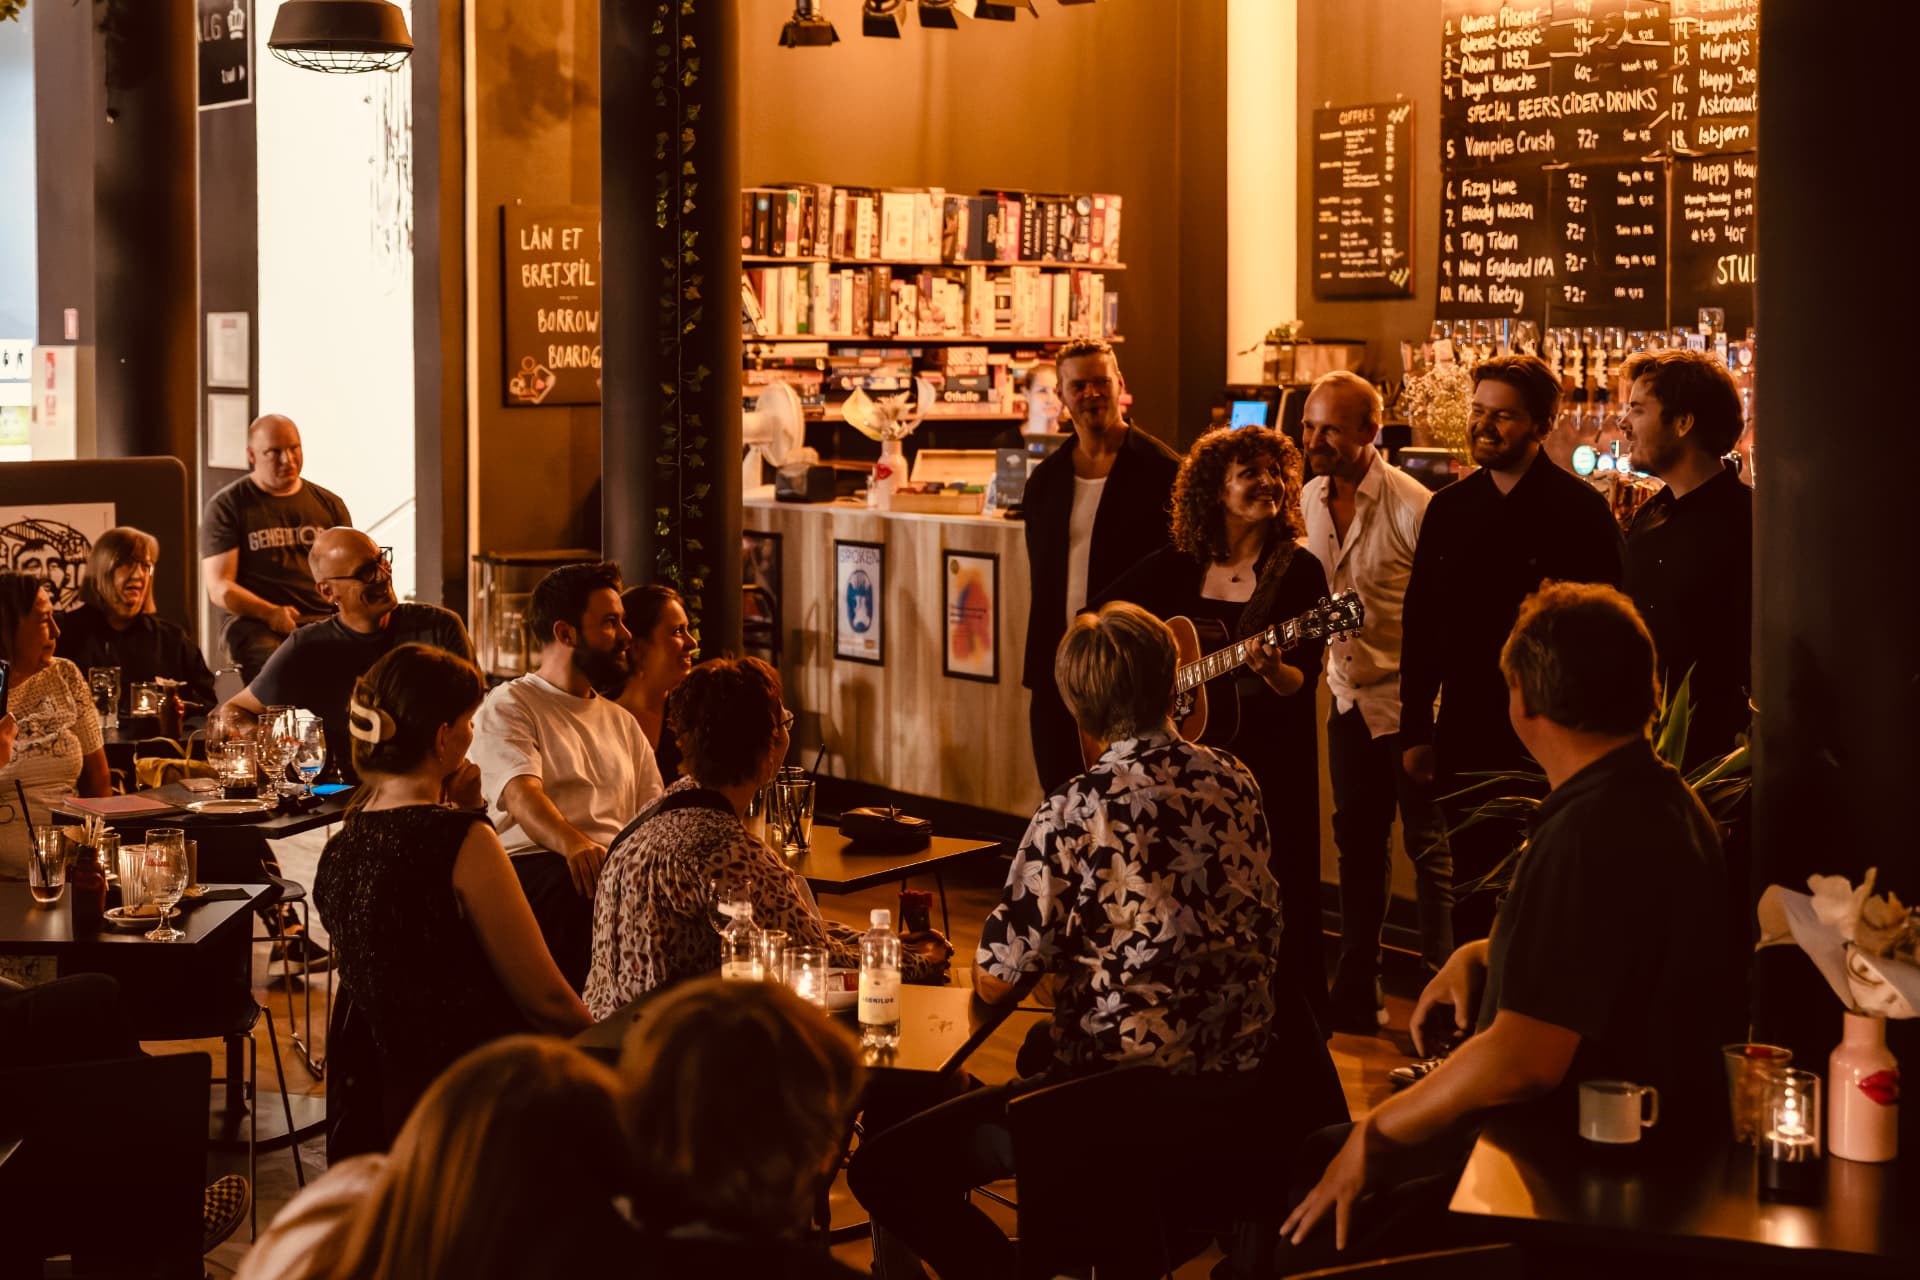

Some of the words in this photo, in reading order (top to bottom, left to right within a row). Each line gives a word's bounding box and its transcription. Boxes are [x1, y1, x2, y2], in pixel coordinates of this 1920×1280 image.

[1461, 15, 1496, 33] Odense
[1500, 7, 1541, 28] Pilsner
[1460, 35, 1497, 54] Odense
[1498, 28, 1543, 49] Classic
[1700, 36, 1750, 65] Murphy's
[1461, 55, 1495, 74] Albani
[1461, 75, 1490, 101] Royal
[1493, 72, 1537, 93] Blanche
[1672, 73, 1689, 95] 16.
[1699, 69, 1733, 93] Happy
[1737, 66, 1757, 84] Joe
[1467, 101, 1516, 123] SPECIAL
[1606, 87, 1658, 113] DRINKS
[1671, 101, 1688, 121] 17.
[1698, 90, 1758, 117] Astronaut
[1465, 133, 1514, 162] Vampire
[1517, 128, 1556, 153] Crush
[1698, 125, 1749, 149] Isbjørn
[1692, 162, 1730, 186] Happy
[1462, 179, 1491, 203] Fizzy
[520, 224, 553, 251] LÅN
[562, 227, 583, 250] ET
[1486, 231, 1519, 250] Titan
[1459, 259, 1481, 277] New
[1486, 256, 1533, 283] England
[1533, 256, 1555, 277] IPA
[1717, 253, 1757, 285] STU
[1458, 283, 1484, 303] Pink
[1488, 283, 1524, 314] Poetry
[537, 308, 600, 333] BORROW
[548, 344, 601, 370] BOARDG
